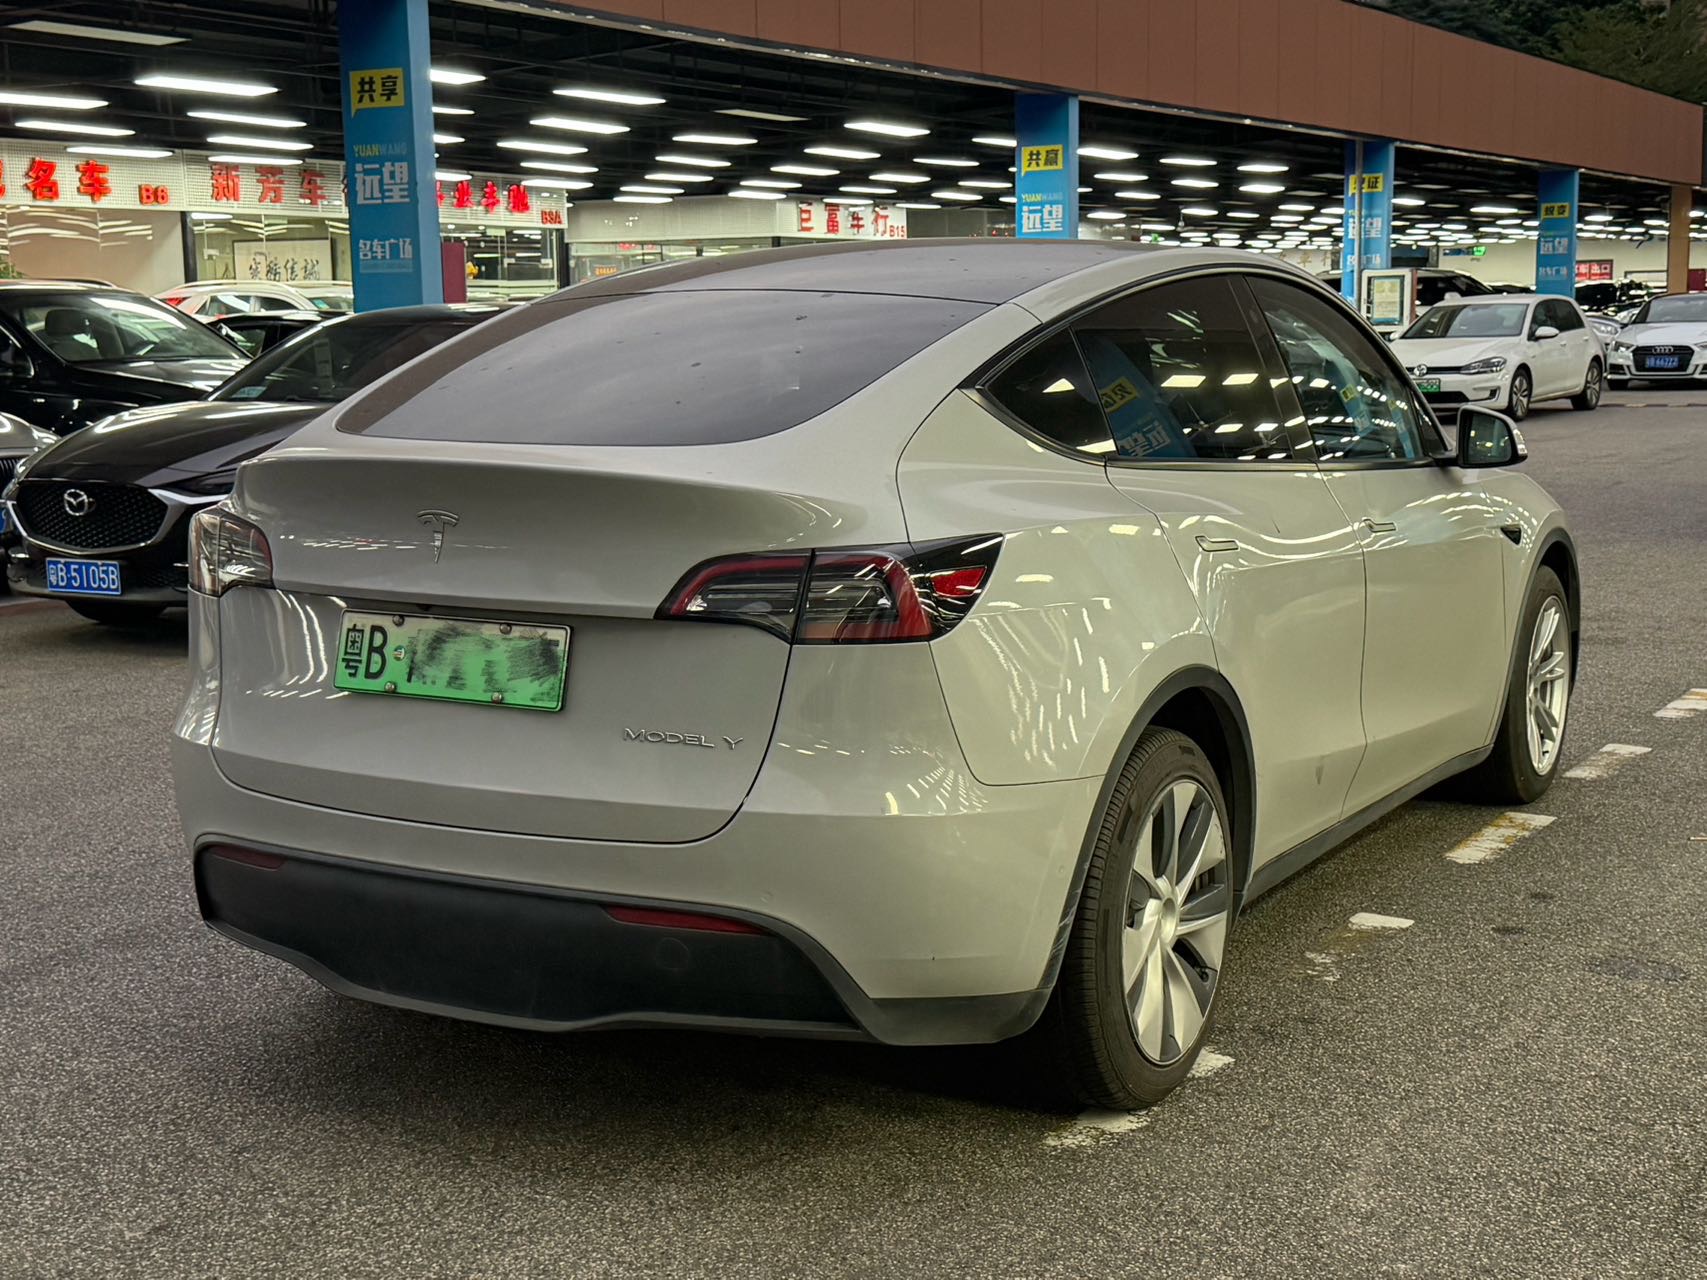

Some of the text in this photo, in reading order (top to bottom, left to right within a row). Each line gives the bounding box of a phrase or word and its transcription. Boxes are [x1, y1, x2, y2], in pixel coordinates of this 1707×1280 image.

[357, 75, 399, 103] 共享
[0, 157, 169, 205] 名车 B6
[211, 163, 348, 207] 新芳车
[354, 161, 411, 205] 远望
[889, 225, 905, 238] B15
[1021, 204, 1064, 234] 远望
[359, 238, 413, 260] 名车广场
[622, 727, 744, 750] MODEL Y
